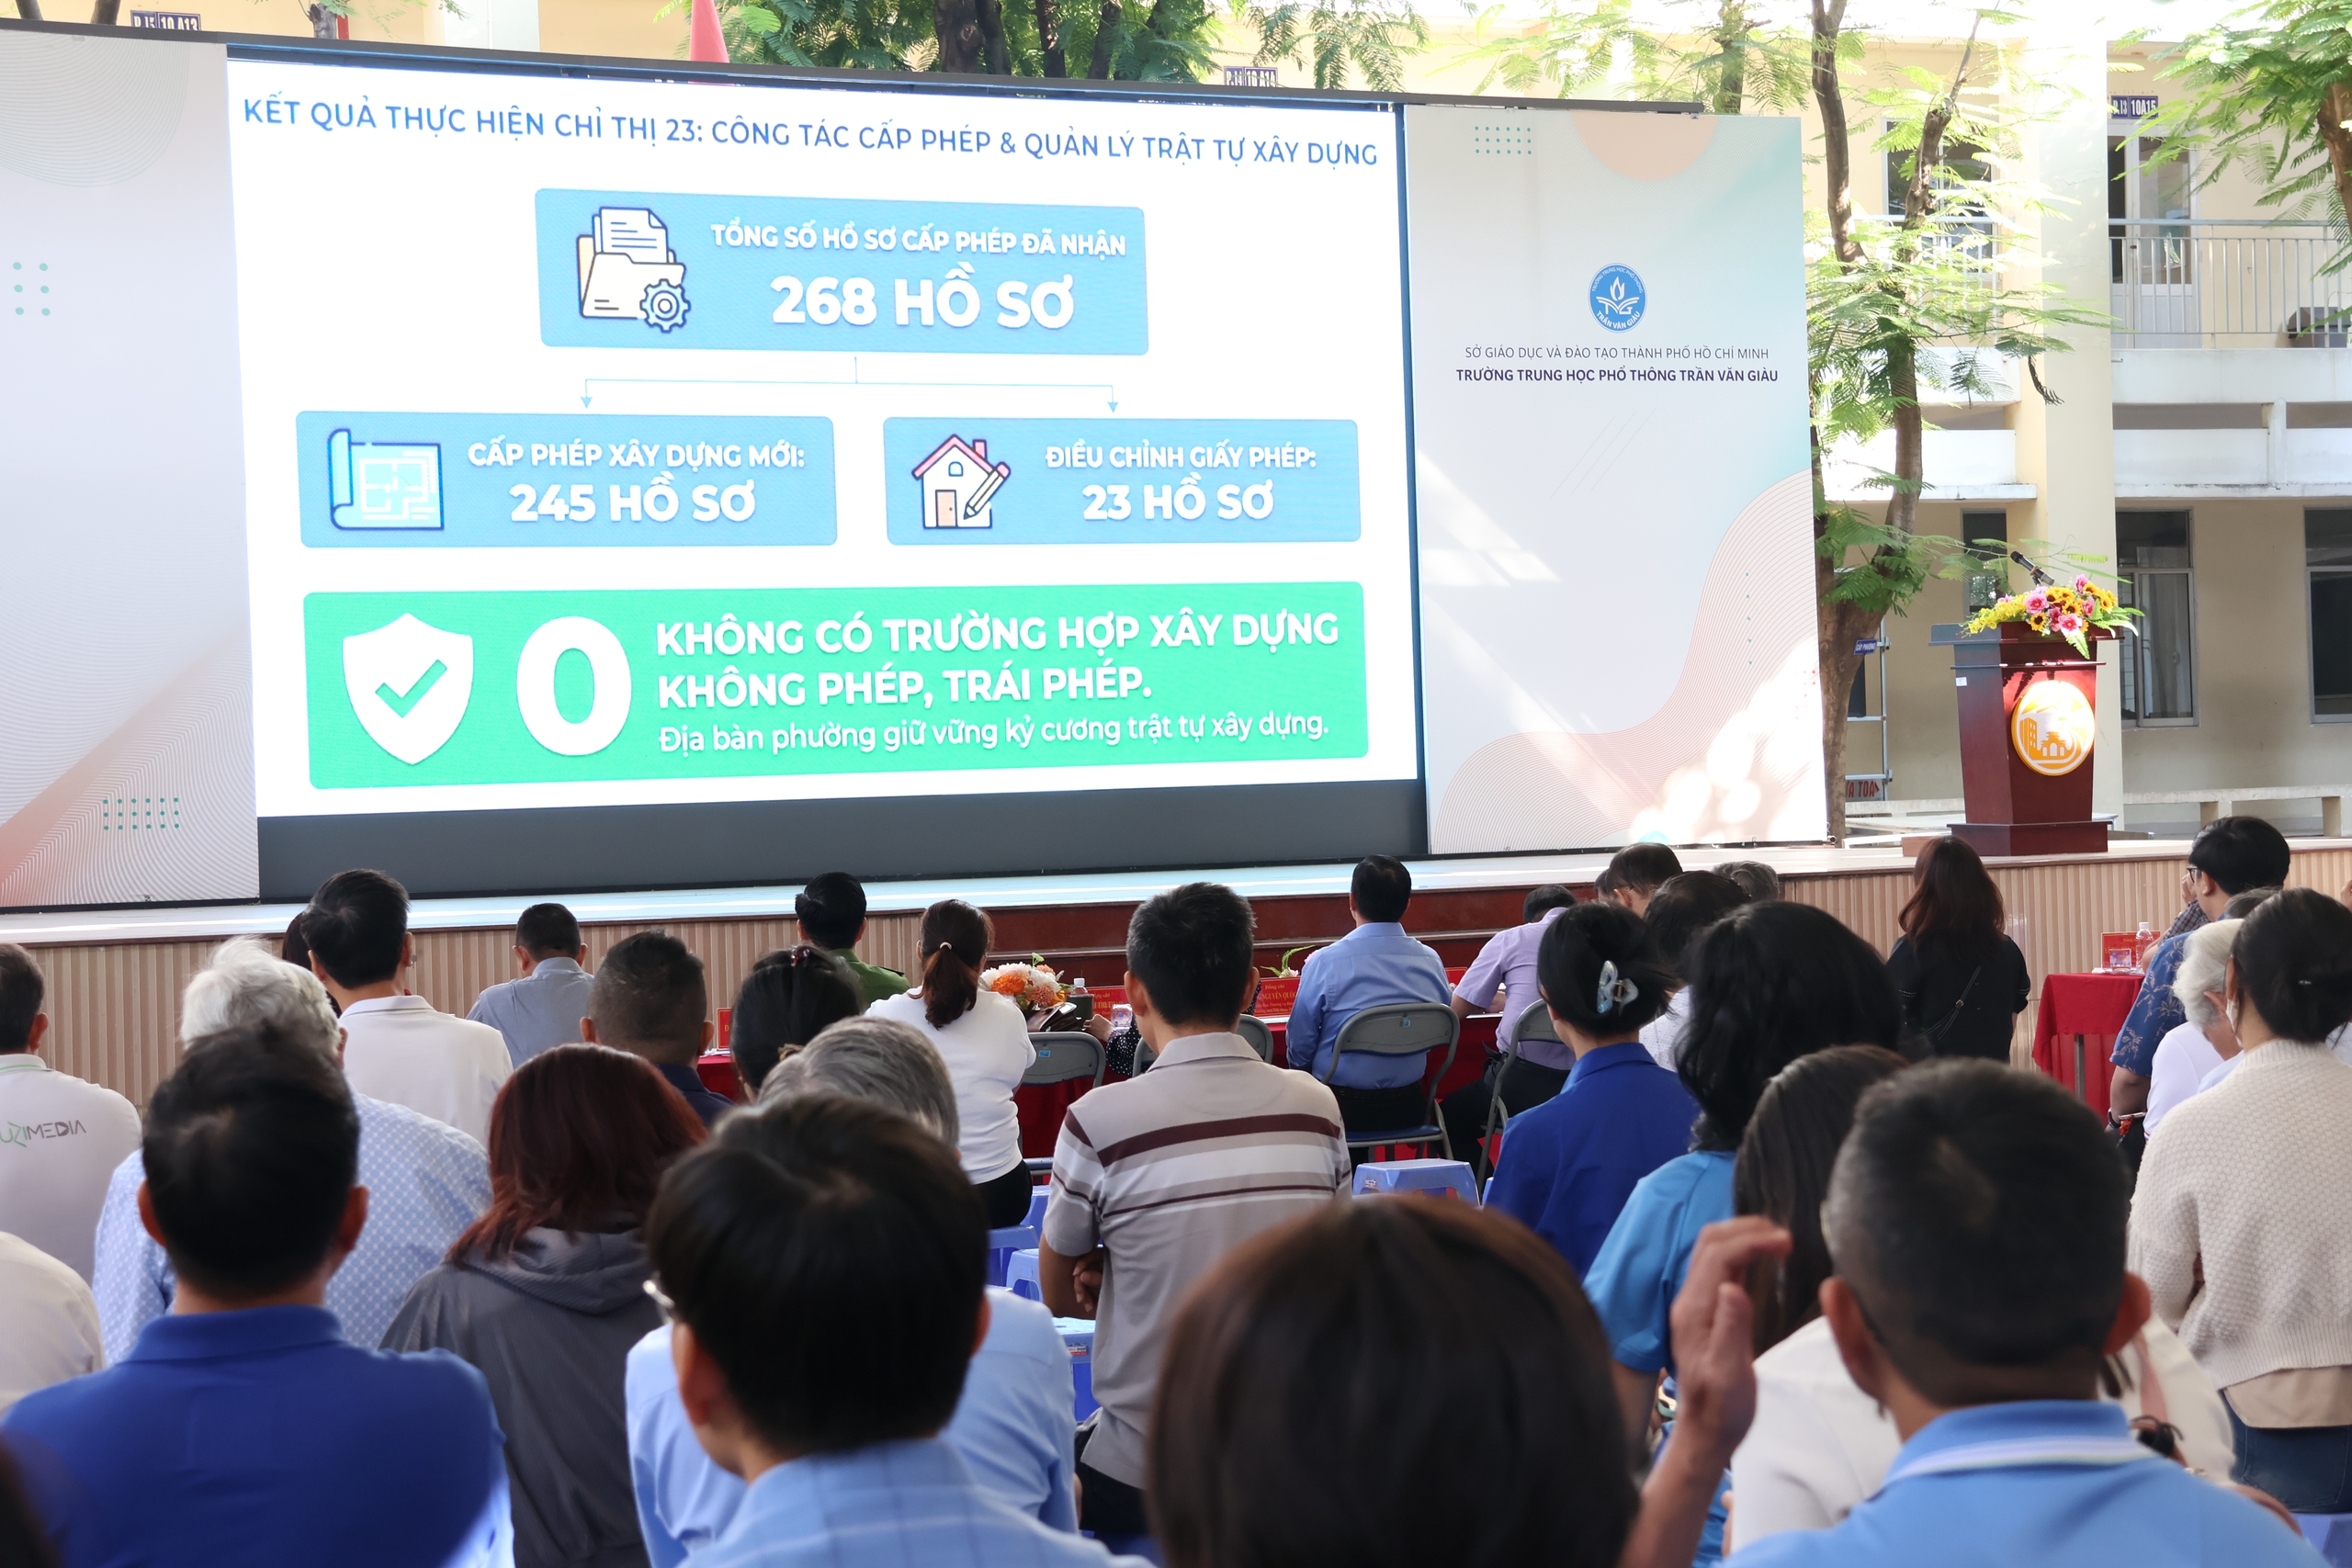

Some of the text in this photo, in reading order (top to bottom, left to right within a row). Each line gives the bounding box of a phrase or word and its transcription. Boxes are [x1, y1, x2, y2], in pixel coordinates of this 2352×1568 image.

[244, 90, 1378, 171] KẾT QUẢ THỰC HIỆN CHỈ THỊ 23: CÔNG TÁC CẤP PHÉP & QUẢN LÝ TRẬT TỰ XÂY DỰNG
[711, 216, 1126, 261] TỔNG SỐ HỒ SƠ CẤP PHÉP ĐÃ NHẬN
[770, 261, 1074, 329] 268 HỒ SƠ
[1456, 366, 1779, 384] TRƯỜNG TRUNG HỌC PHỔ THÔNG TRẦN VĂN GIÀU
[1465, 344, 1769, 361] SỞ GIÁO DỤC VÀ ĐÀO TẠO THÀNH PHỐ HỒ CHÍ MINH
[468, 434, 806, 472] CẤP PHÉP XÂY DỰNG MỚI:
[1046, 437, 1317, 468] ĐIỀU CHỈNH GIẤY PHÉP:
[509, 470, 756, 522] 245 HỒ SƠ
[1082, 471, 1274, 520] 23 HỒ SƠ
[656, 606, 1339, 657] KHÔNG CÓ TRƯỜNG HỢP XÂY DỰNG
[516, 616, 632, 756] 0
[658, 658, 1152, 709] KHÔNG PHÉP, TRÁI PHÉP.
[659, 711, 1329, 757] Địa bàn phường giữ vững kỷ cương trật tự xây dựng.
